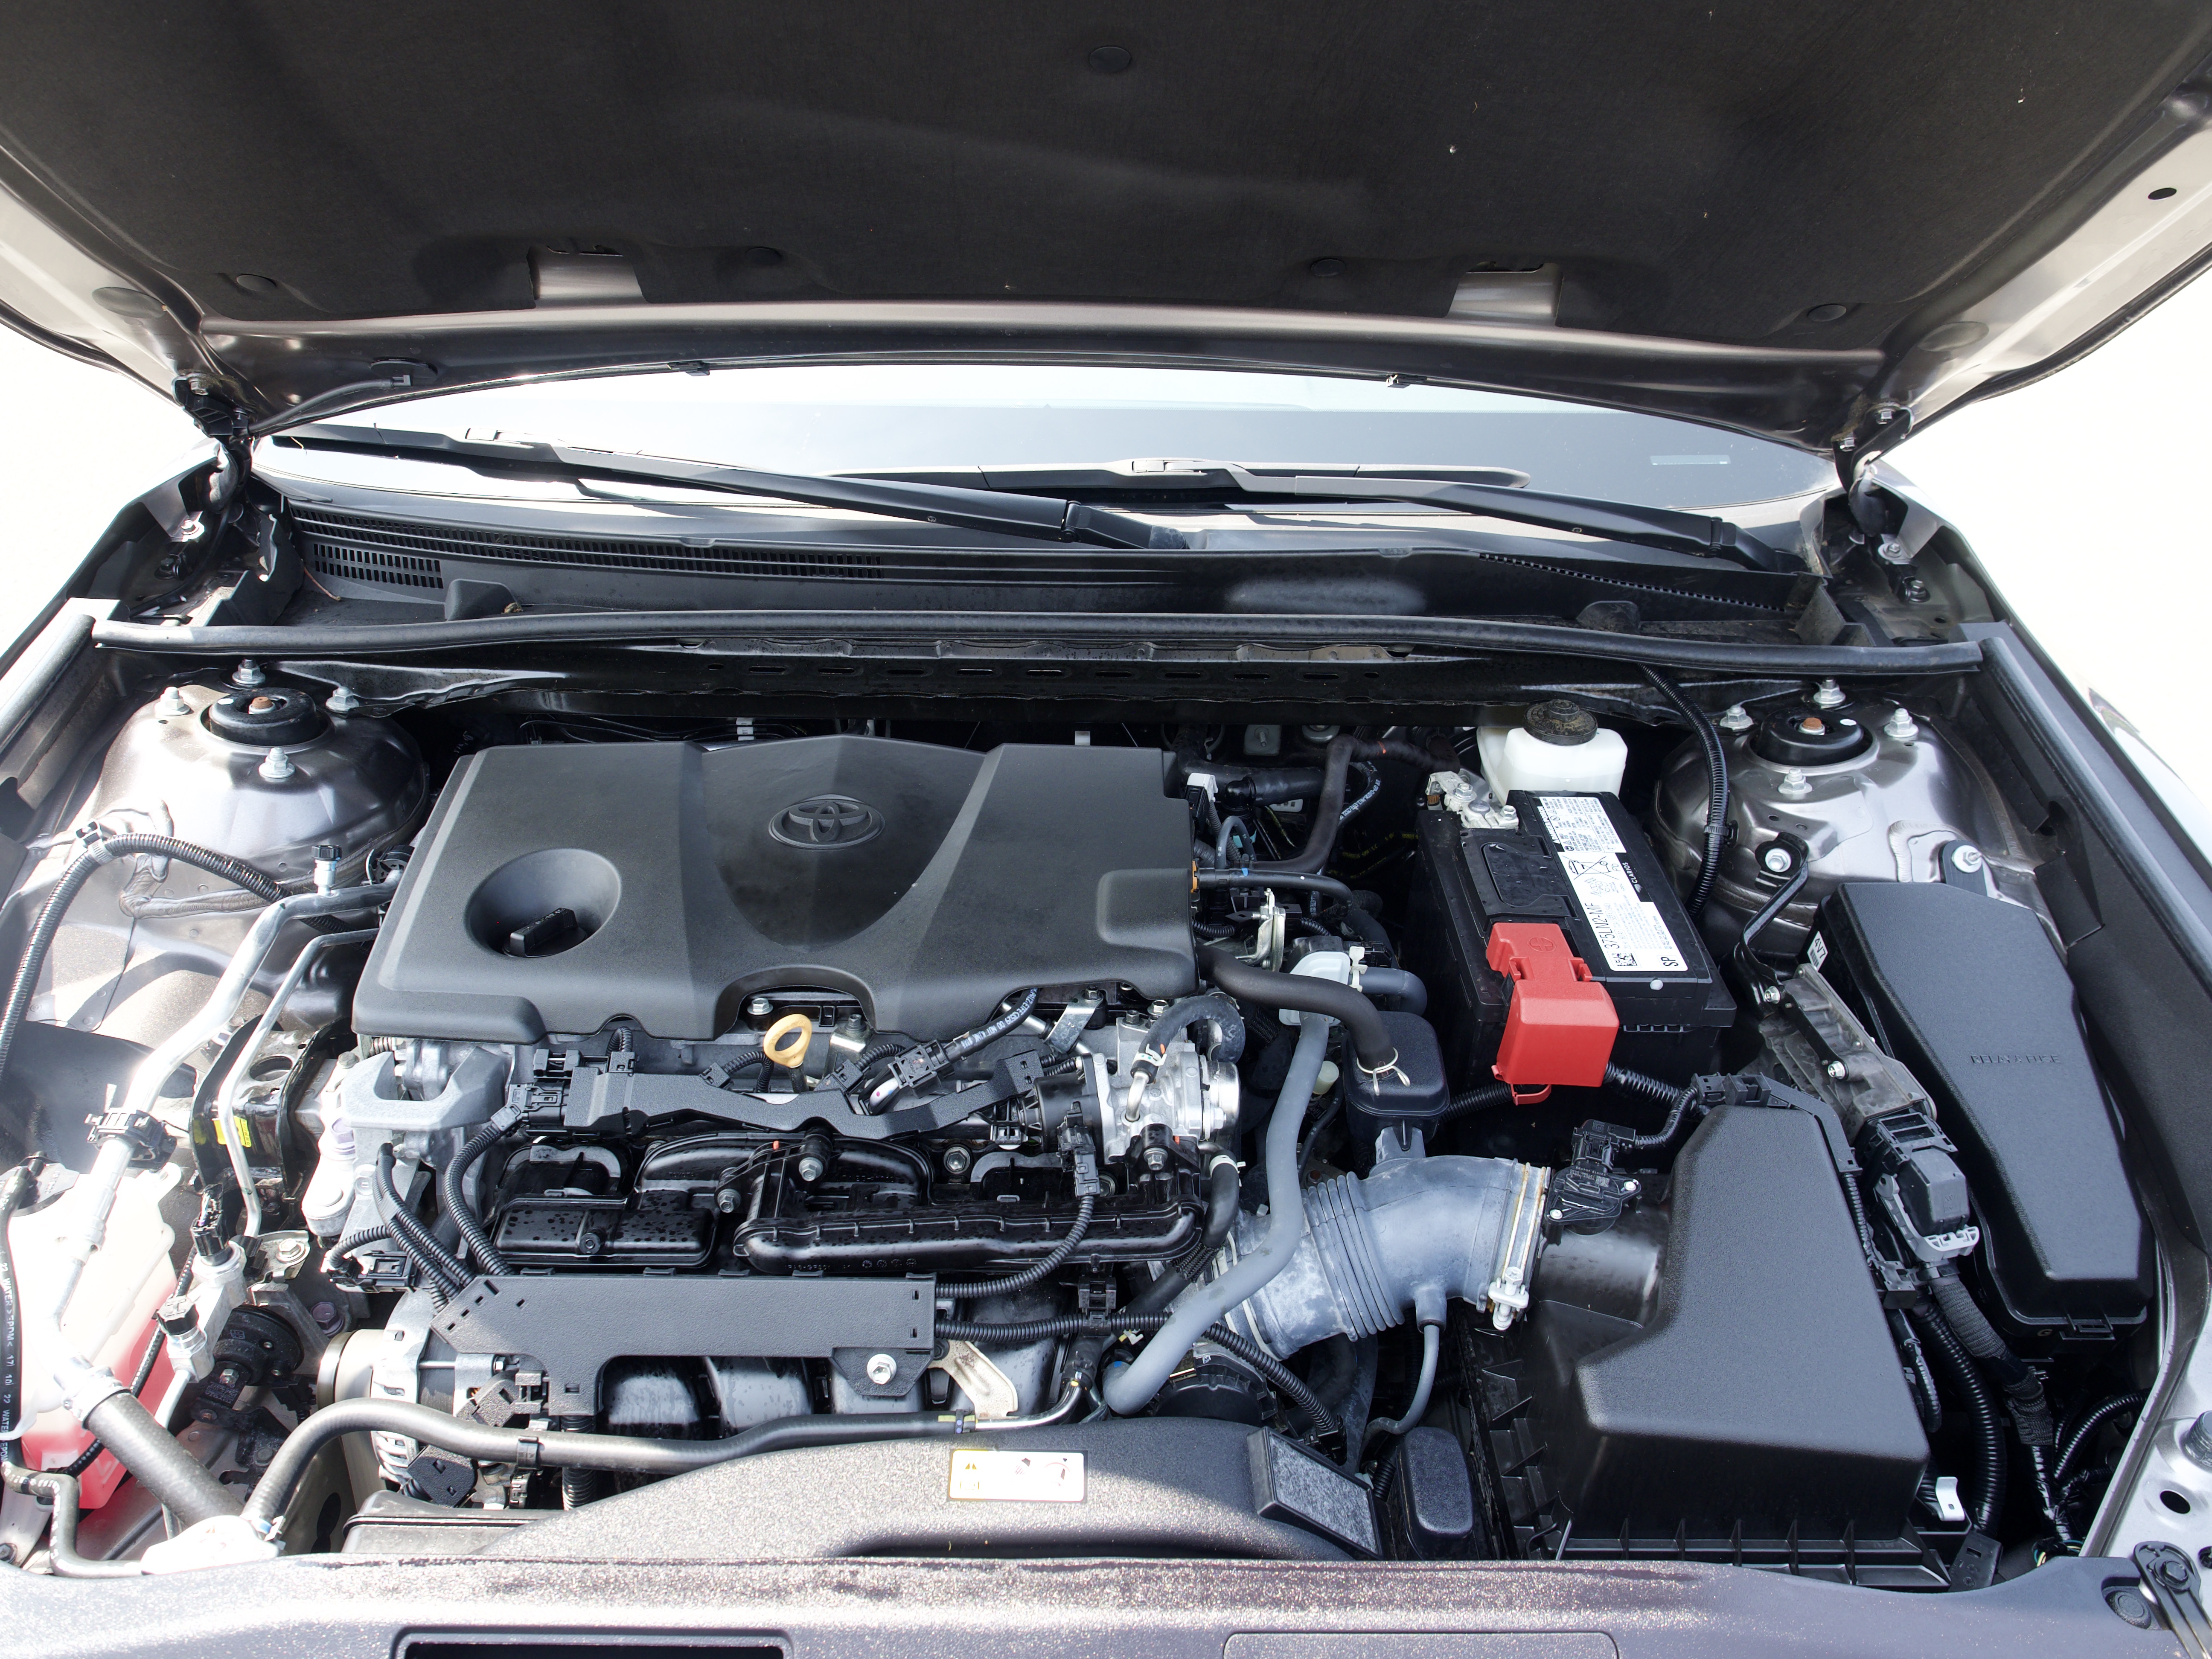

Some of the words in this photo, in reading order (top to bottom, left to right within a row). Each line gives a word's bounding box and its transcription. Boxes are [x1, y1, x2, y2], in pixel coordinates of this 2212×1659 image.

[1612, 863, 1621, 872] Pb
[1622, 862, 1638, 884] CLARIOS
[1584, 903, 1620, 949] 375LN2-MF
[1815, 938, 1826, 958] 4V7
[1661, 957, 1679, 966] SP
[1970, 1054, 2010, 1064] RELAY
[2026, 1054, 2062, 1064] FUSE
[2, 1278, 13, 1306] WATER
